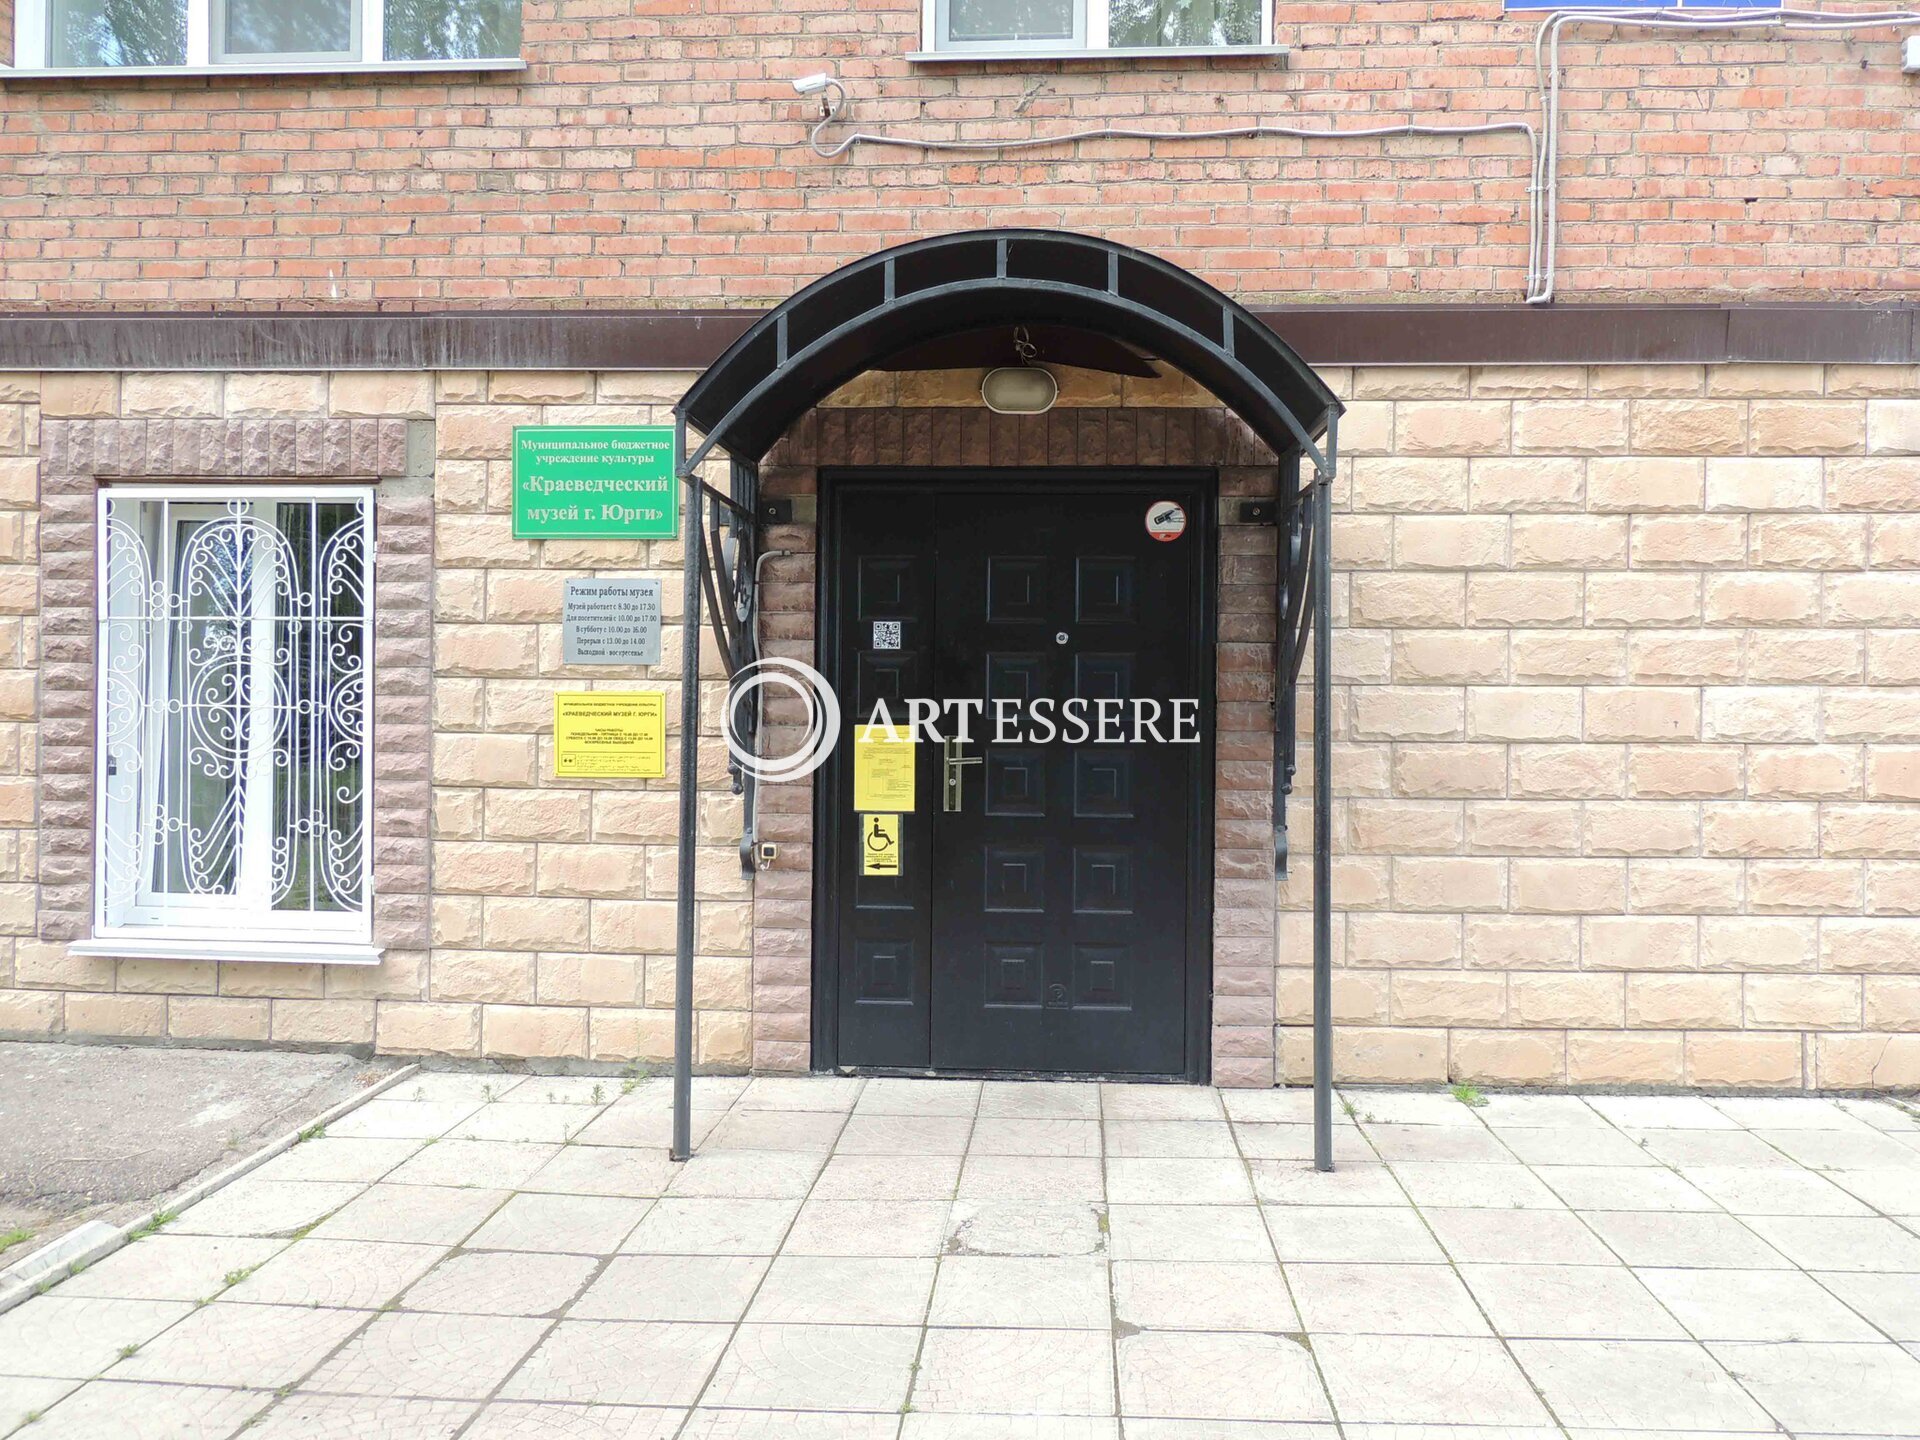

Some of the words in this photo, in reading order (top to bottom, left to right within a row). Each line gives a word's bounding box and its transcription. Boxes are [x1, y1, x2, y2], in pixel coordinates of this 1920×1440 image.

[521, 440, 609, 451] Муниципальное
[611, 440, 670, 450] бюджетное
[536, 455, 599, 465] учреждение
[602, 455, 654, 465] культуры
[522, 476, 668, 495] «Краеведческий
[528, 505, 578, 524] музей
[584, 510, 595, 520] г.
[601, 504, 663, 524] Юрги»
[570, 586, 597, 596] Режим
[599, 586, 628, 598] работы
[630, 589, 653, 599] музея
[567, 603, 586, 611] Музей
[587, 603, 613, 611] работает
[640, 603, 656, 611] 17.30
